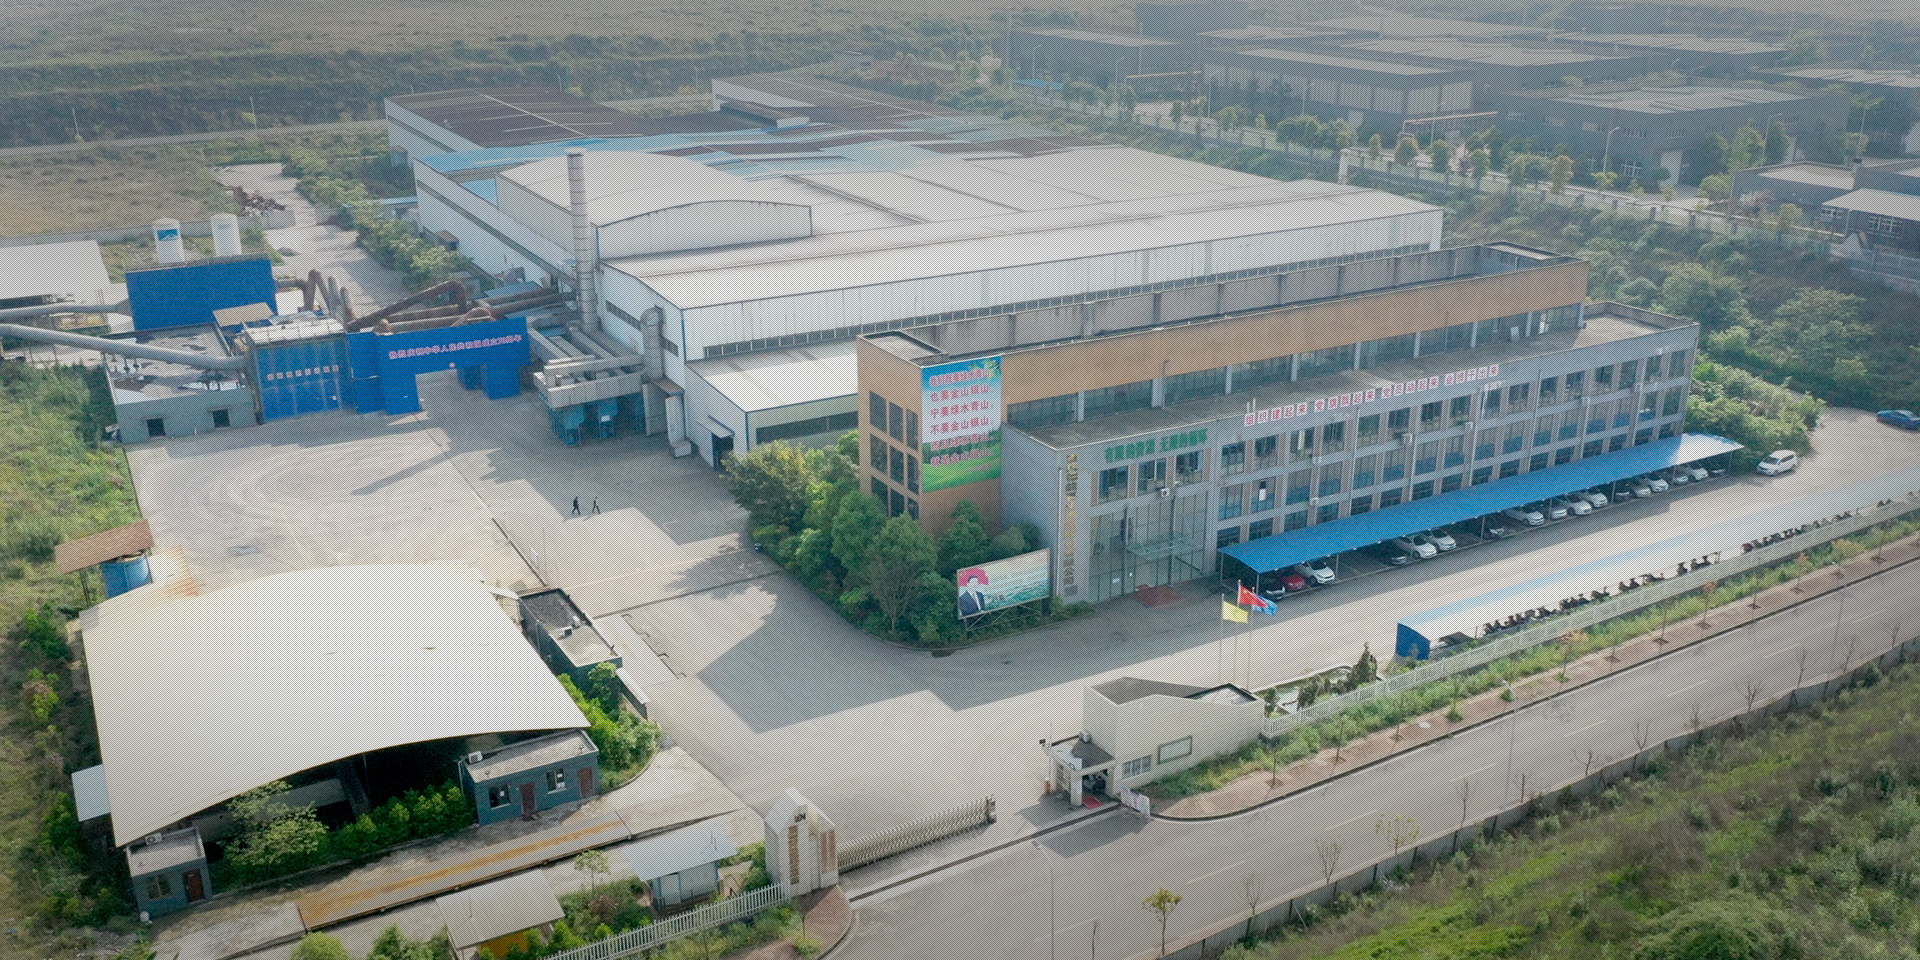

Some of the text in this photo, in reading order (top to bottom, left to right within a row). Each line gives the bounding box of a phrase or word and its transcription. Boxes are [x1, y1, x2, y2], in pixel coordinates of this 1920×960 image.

[1245, 365, 1498, 426] 组织建起来 党旗飘起来 党员动起来 业绩干出来
[1104, 428, 1208, 464] 有限的资源 无限的循环
